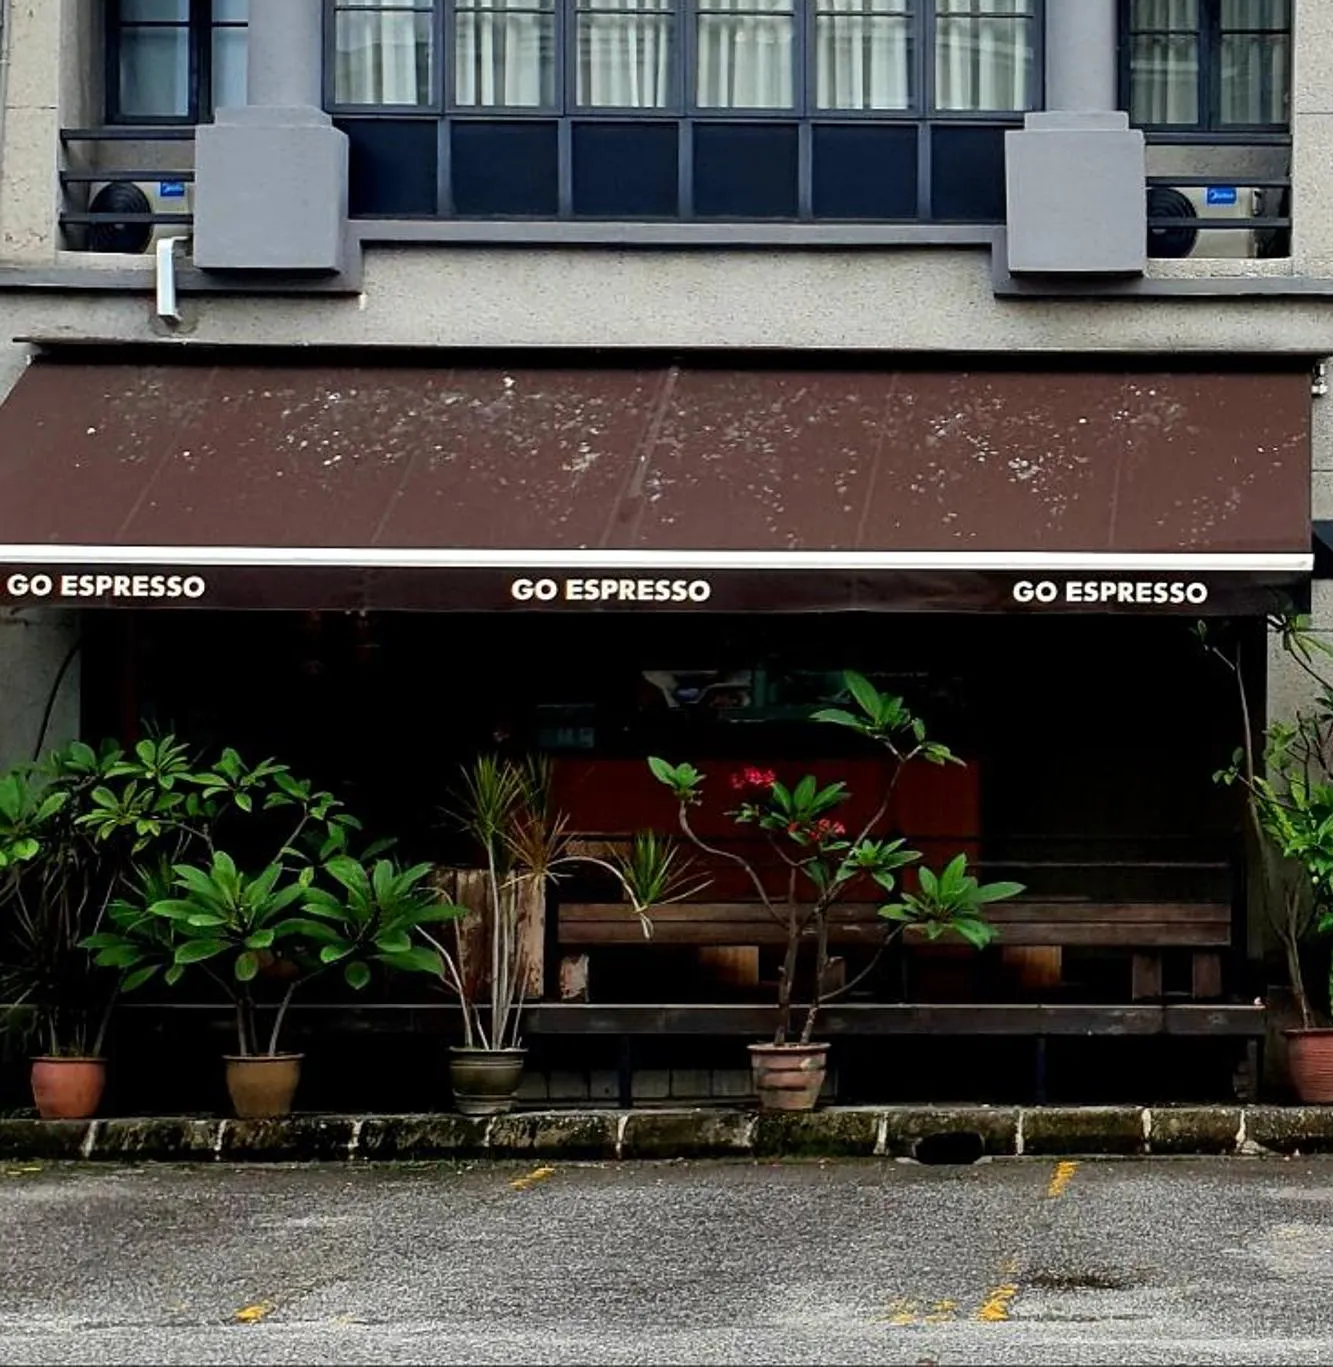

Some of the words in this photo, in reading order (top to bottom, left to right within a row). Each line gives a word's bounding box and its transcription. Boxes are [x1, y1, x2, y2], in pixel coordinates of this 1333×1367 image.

[7, 573, 52, 596] GO
[60, 575, 205, 598] ESPRESSO
[511, 577, 558, 601] GO
[565, 578, 711, 602] ESPRESSO
[1013, 580, 1058, 602] GO
[1066, 581, 1208, 604] ESPRESSO
